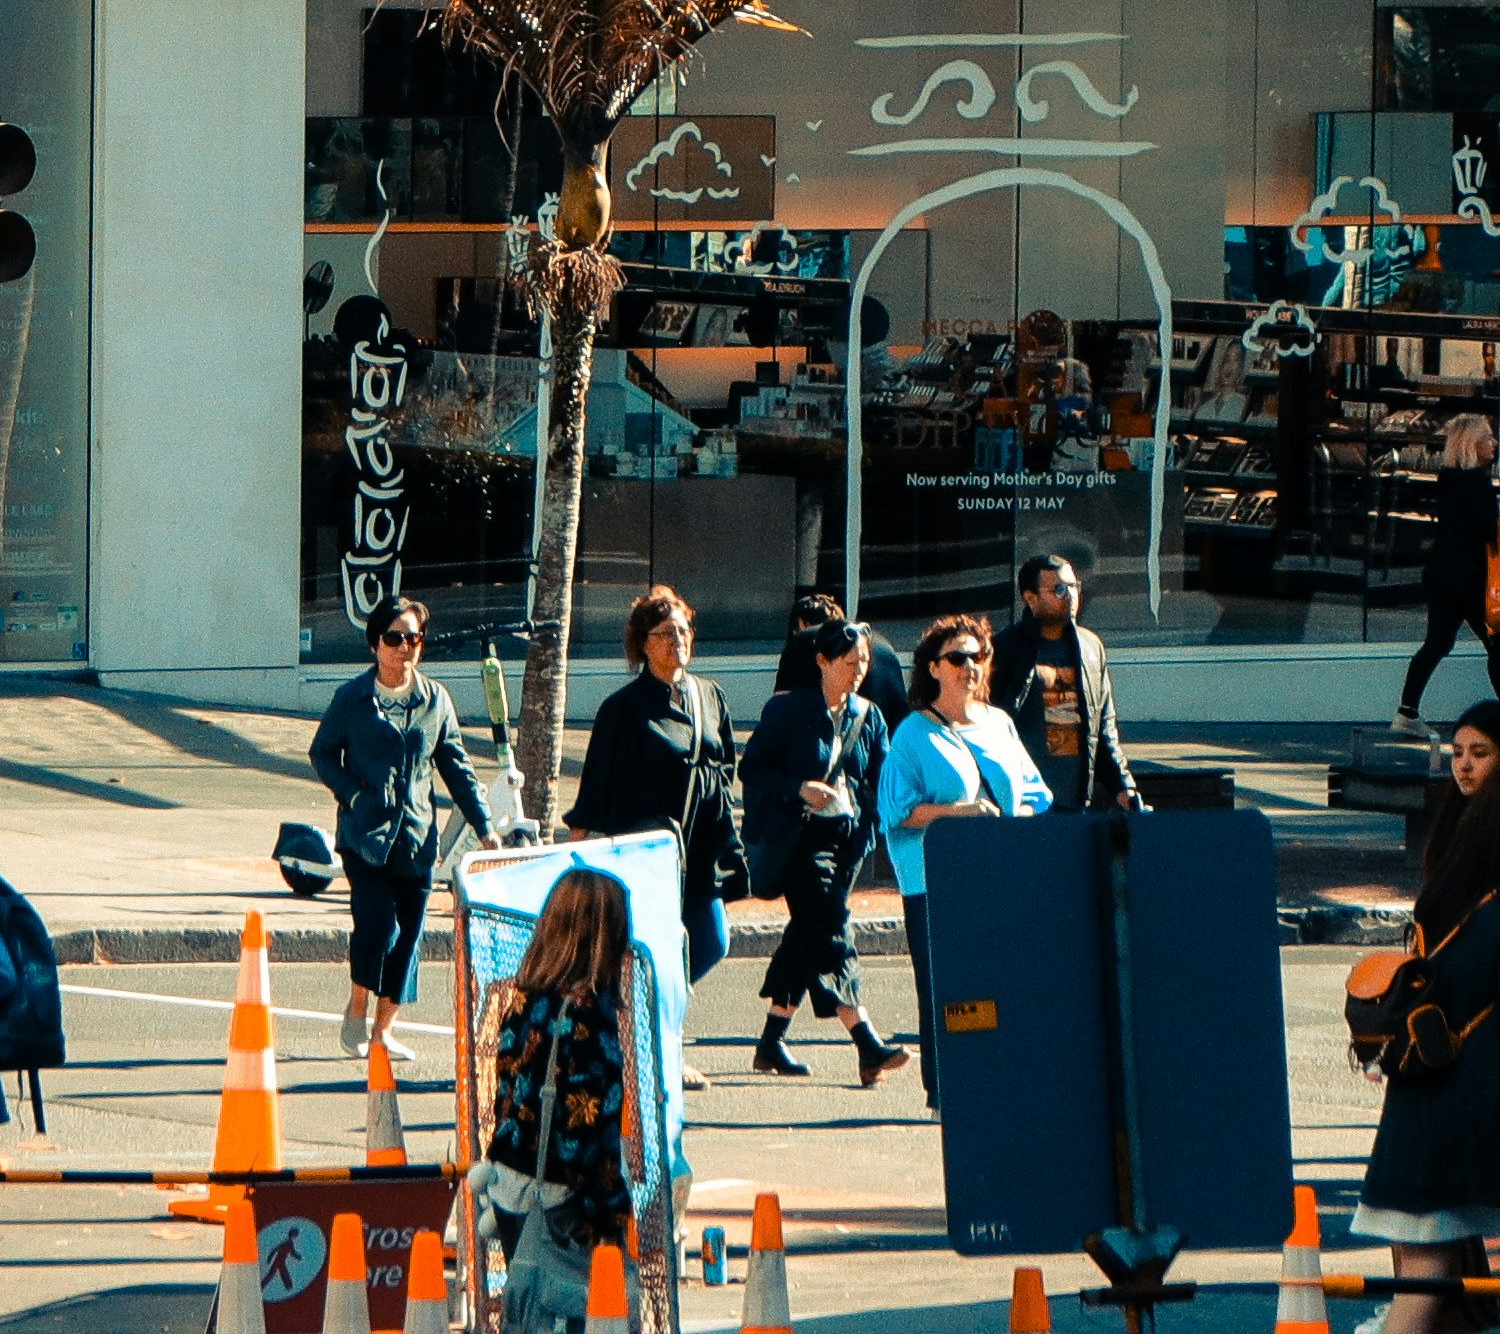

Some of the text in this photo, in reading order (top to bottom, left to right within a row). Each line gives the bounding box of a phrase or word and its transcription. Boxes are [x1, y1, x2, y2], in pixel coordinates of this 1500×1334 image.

[906, 471, 1117, 490] Now serving Mother's Day gifts
[957, 497, 1066, 510] SUNDAY 12 MAY
[363, 1223, 430, 1250] ros
[366, 1265, 403, 1288] re
